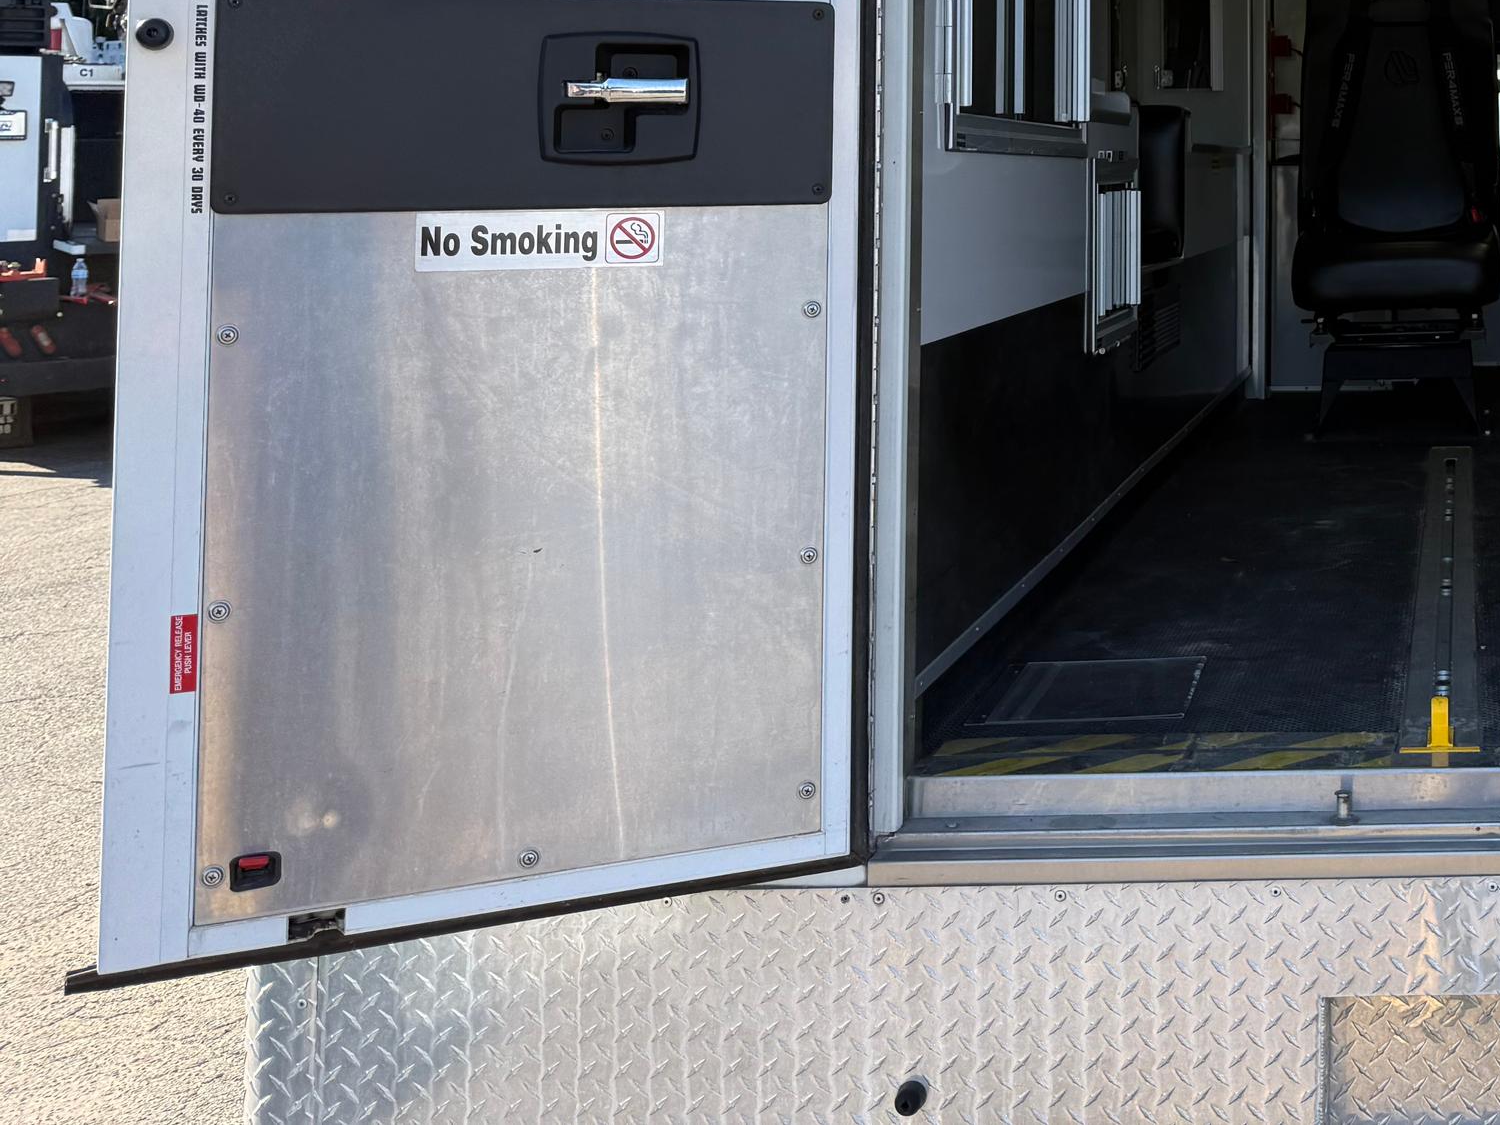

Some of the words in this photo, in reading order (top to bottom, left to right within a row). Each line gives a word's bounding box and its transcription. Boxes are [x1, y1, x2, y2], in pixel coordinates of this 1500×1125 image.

[195, 4, 209, 47] LATCHES
[79, 68, 94, 77] C1
[194, 51, 207, 79] WITH
[193, 84, 206, 123] WD-40
[192, 128, 205, 162] EVERY
[191, 167, 204, 181] 30
[190, 186, 203, 214] DAYS
[420, 226, 461, 256] No
[470, 223, 598, 262] Smoking
[174, 616, 183, 647] RELEASE
[184, 632, 192, 653] LEVER
[174, 650, 183, 691] EMERGENCY
[184, 654, 192, 674] PUSH
